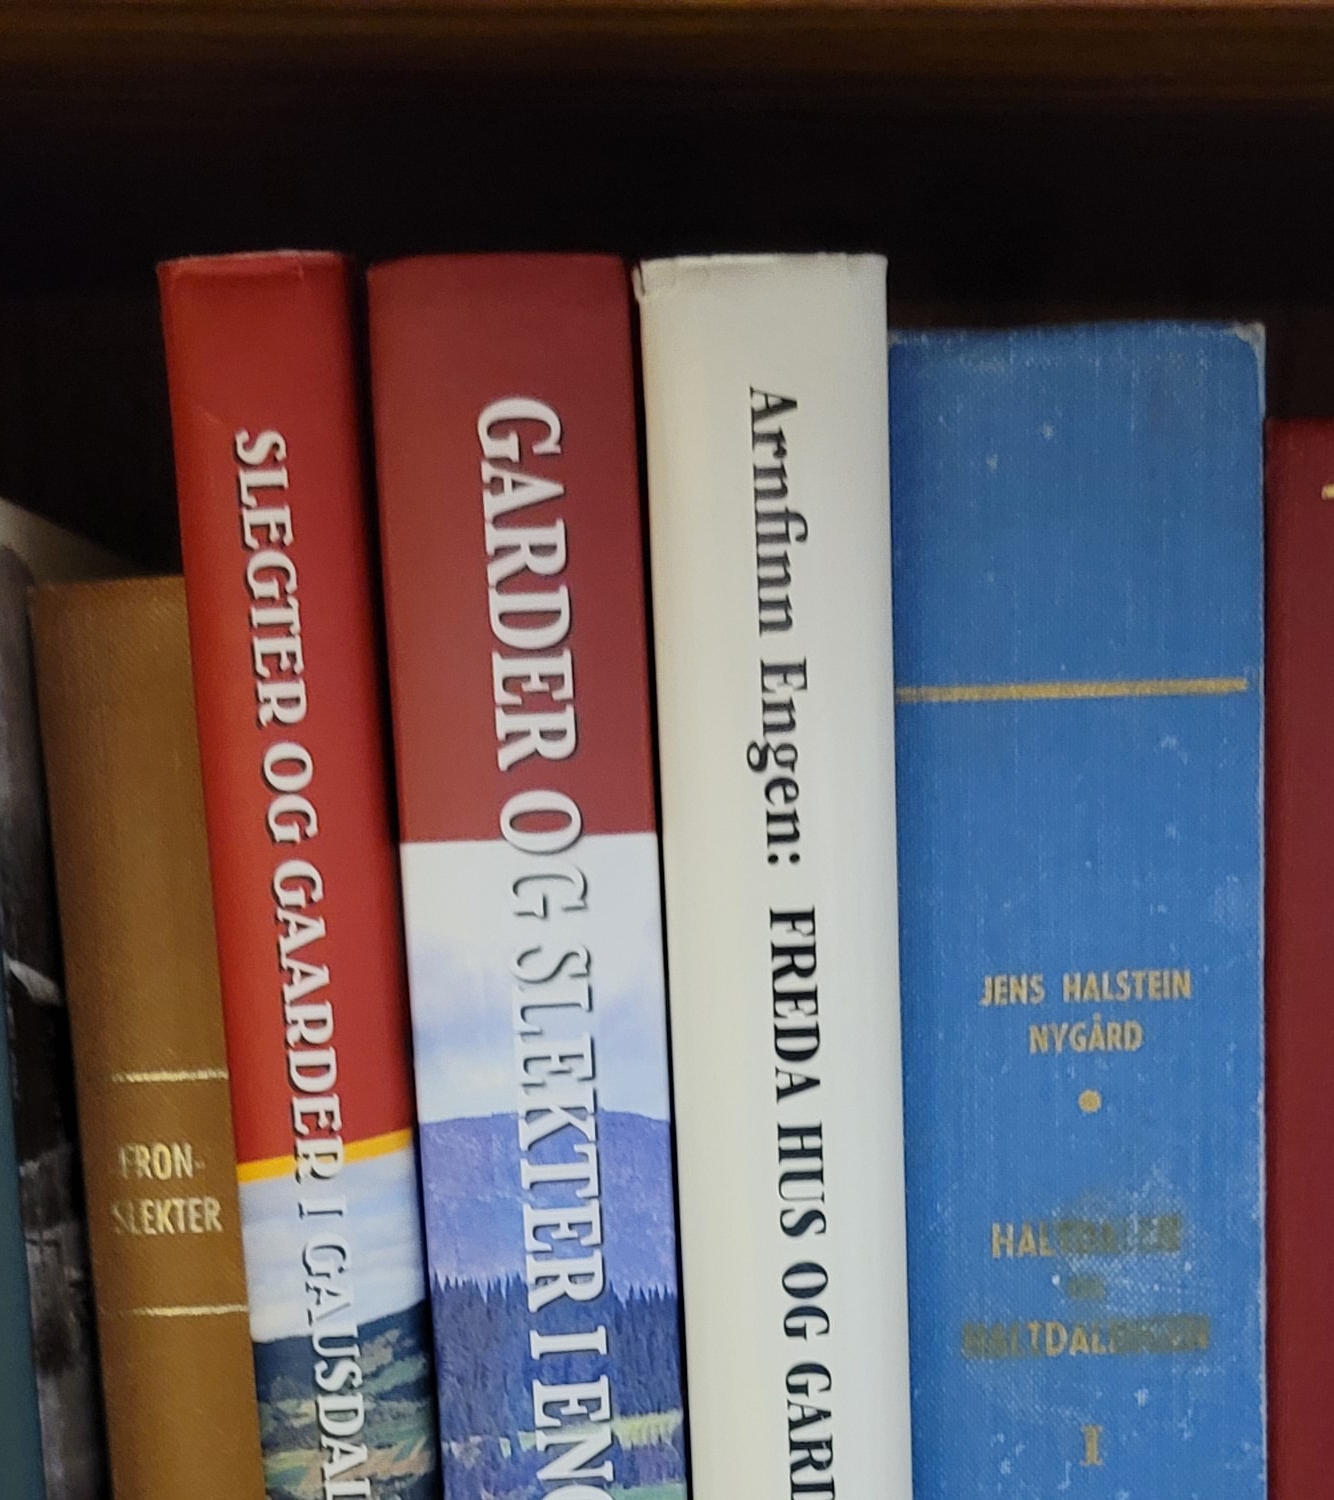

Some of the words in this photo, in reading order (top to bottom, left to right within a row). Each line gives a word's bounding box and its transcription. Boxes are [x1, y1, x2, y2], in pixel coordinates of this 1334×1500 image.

[749, 386, 809, 638] Arnfinn
[234, 428, 307, 728] SLEGTER
[477, 396, 579, 772] GARDER
[262, 741, 319, 844] OG
[746, 657, 809, 866] Engen:
[499, 789, 589, 920] OG
[272, 858, 345, 1184] GAARDER
[769, 905, 822, 1104] FREDA
[978, 972, 1045, 1007] JENS
[1062, 968, 1193, 1003] HALSTEIN
[1028, 1012, 1143, 1055] NYGÅRD
[511, 945, 606, 1312] SLEKTER
[777, 1121, 828, 1238] HUS
[298, 1202, 348, 1220] I
[529, 1325, 609, 1360] I
[781, 1261, 832, 1342] OG
[1080, 1424, 1104, 1467] I
